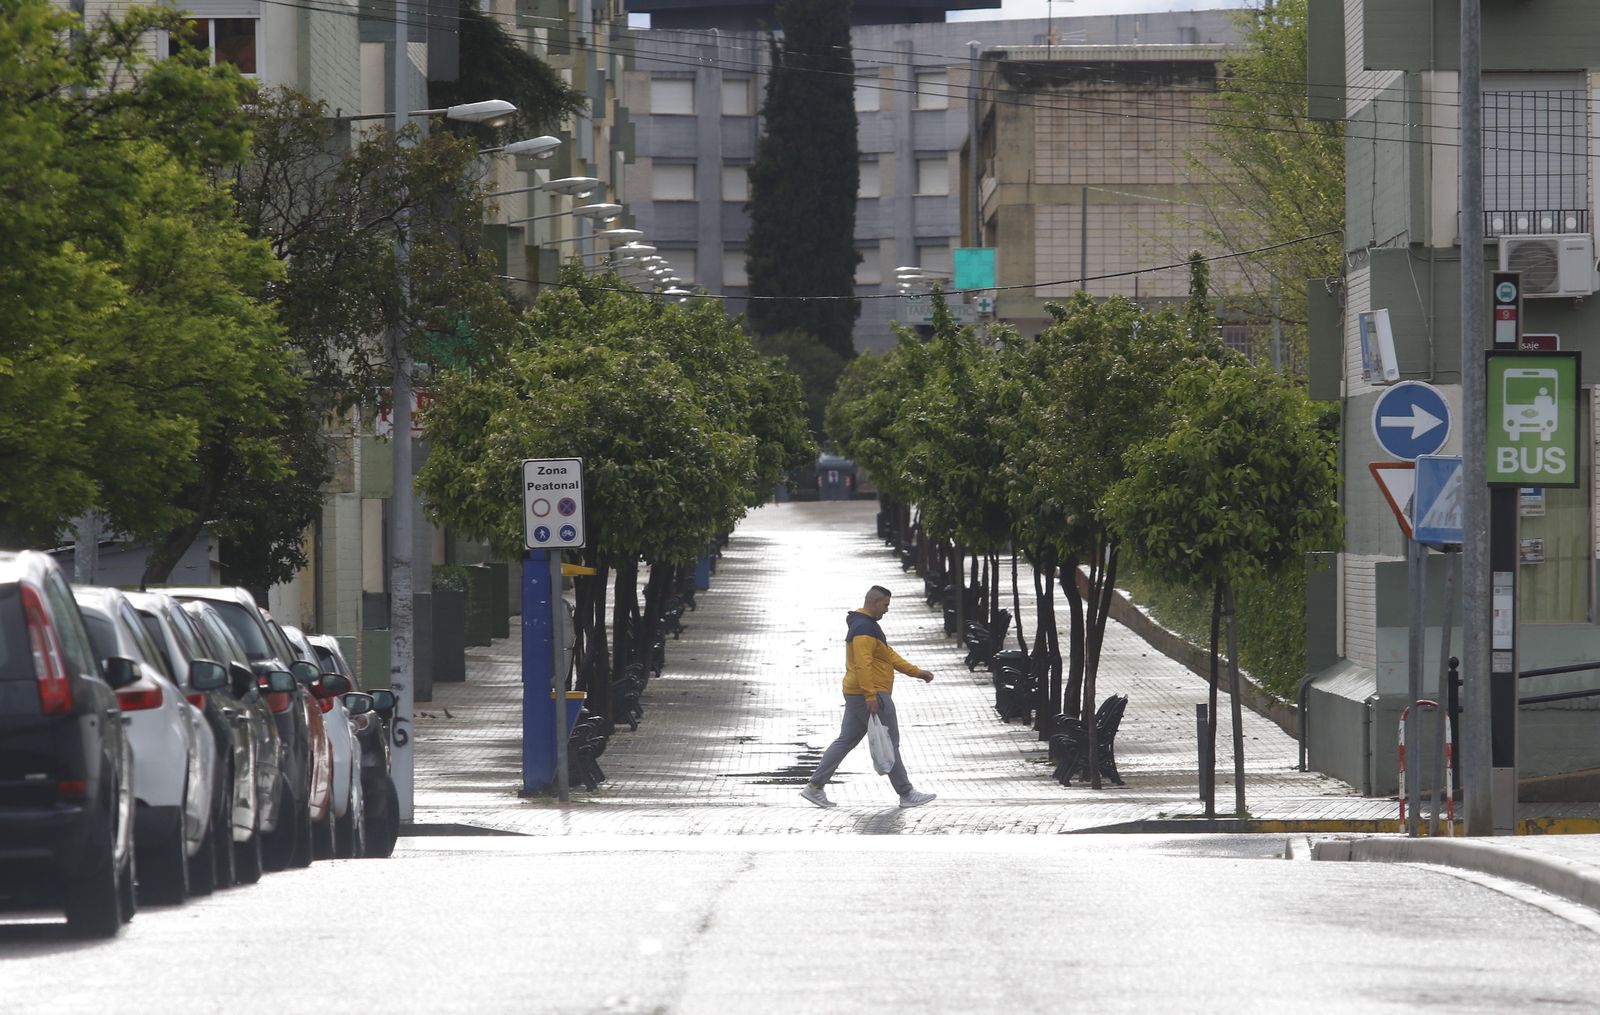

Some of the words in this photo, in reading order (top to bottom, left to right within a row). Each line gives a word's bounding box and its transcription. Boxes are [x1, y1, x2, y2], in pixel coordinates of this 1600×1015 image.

[1521, 341, 1540, 351] saje
[1496, 446, 1567, 474] BUS
[537, 466, 567, 475] Zona
[527, 480, 579, 491] Peatonal
